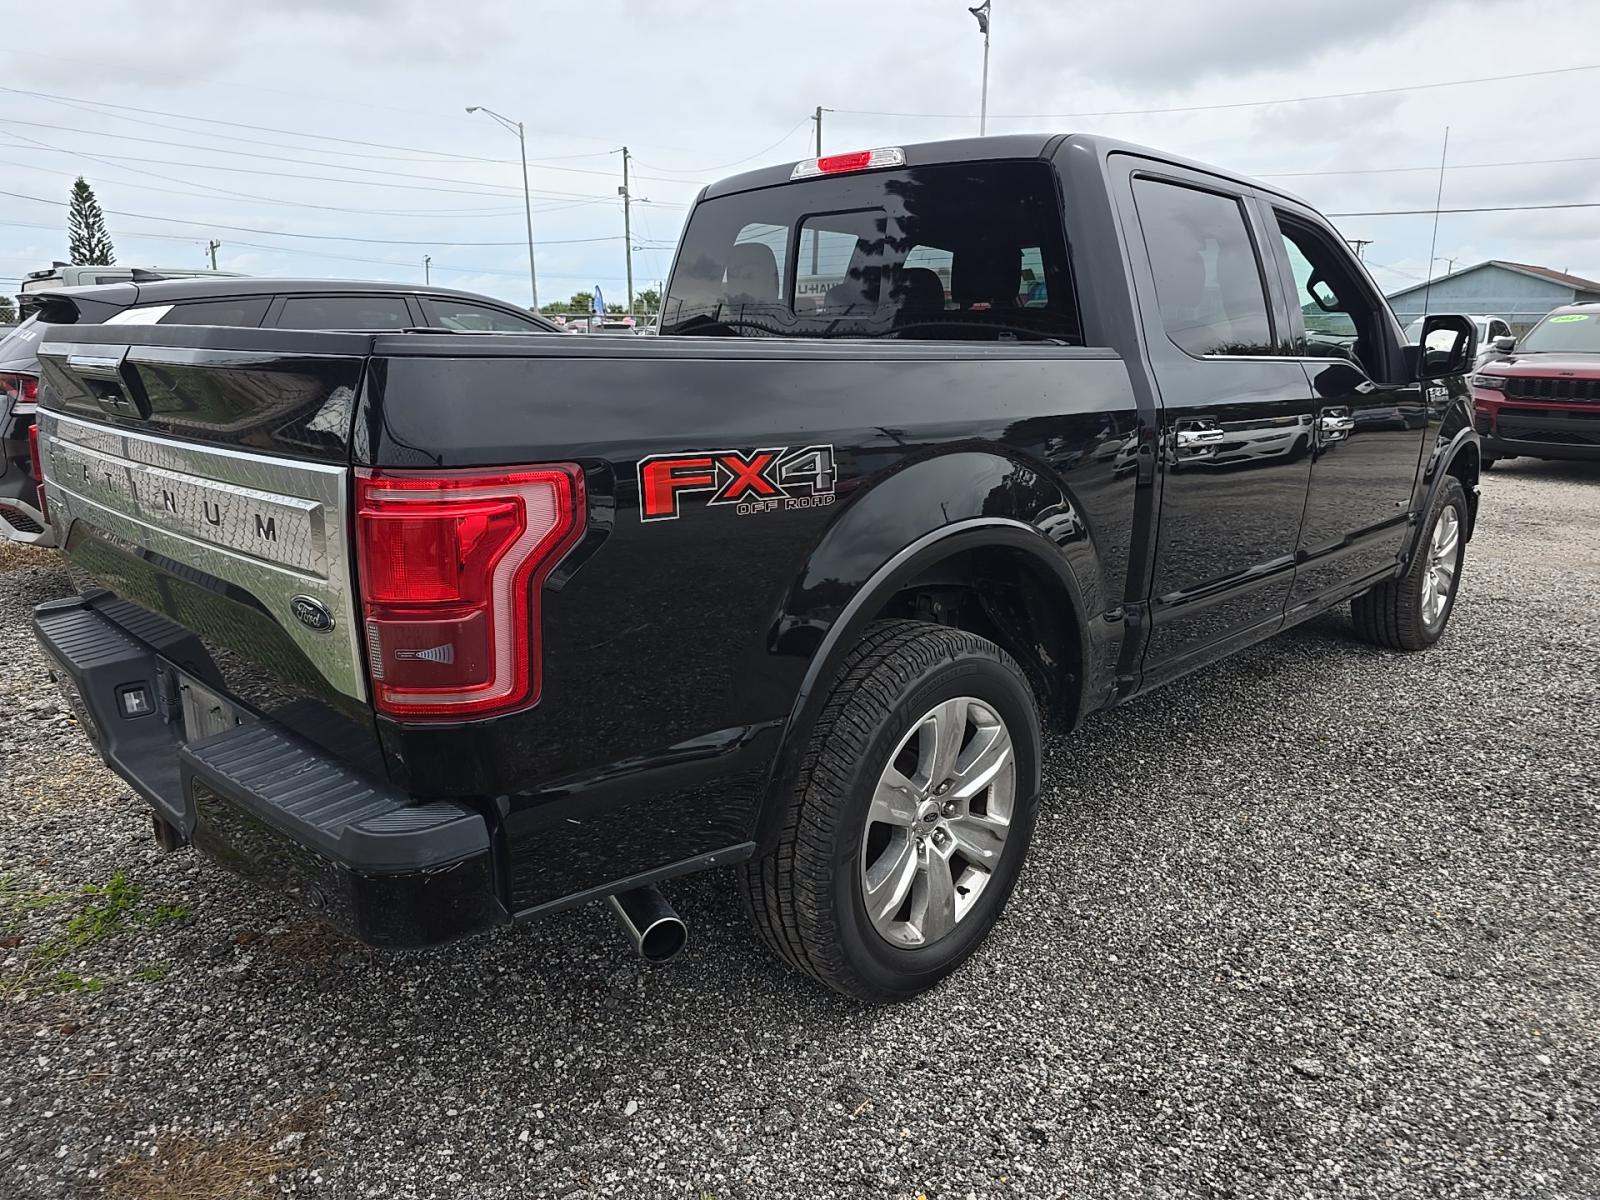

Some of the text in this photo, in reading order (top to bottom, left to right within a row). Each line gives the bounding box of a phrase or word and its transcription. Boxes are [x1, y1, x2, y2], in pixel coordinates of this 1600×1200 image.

[637, 444, 837, 523] FX4
[736, 494, 836, 516] OFF ROAD
[296, 601, 321, 627] Ford
